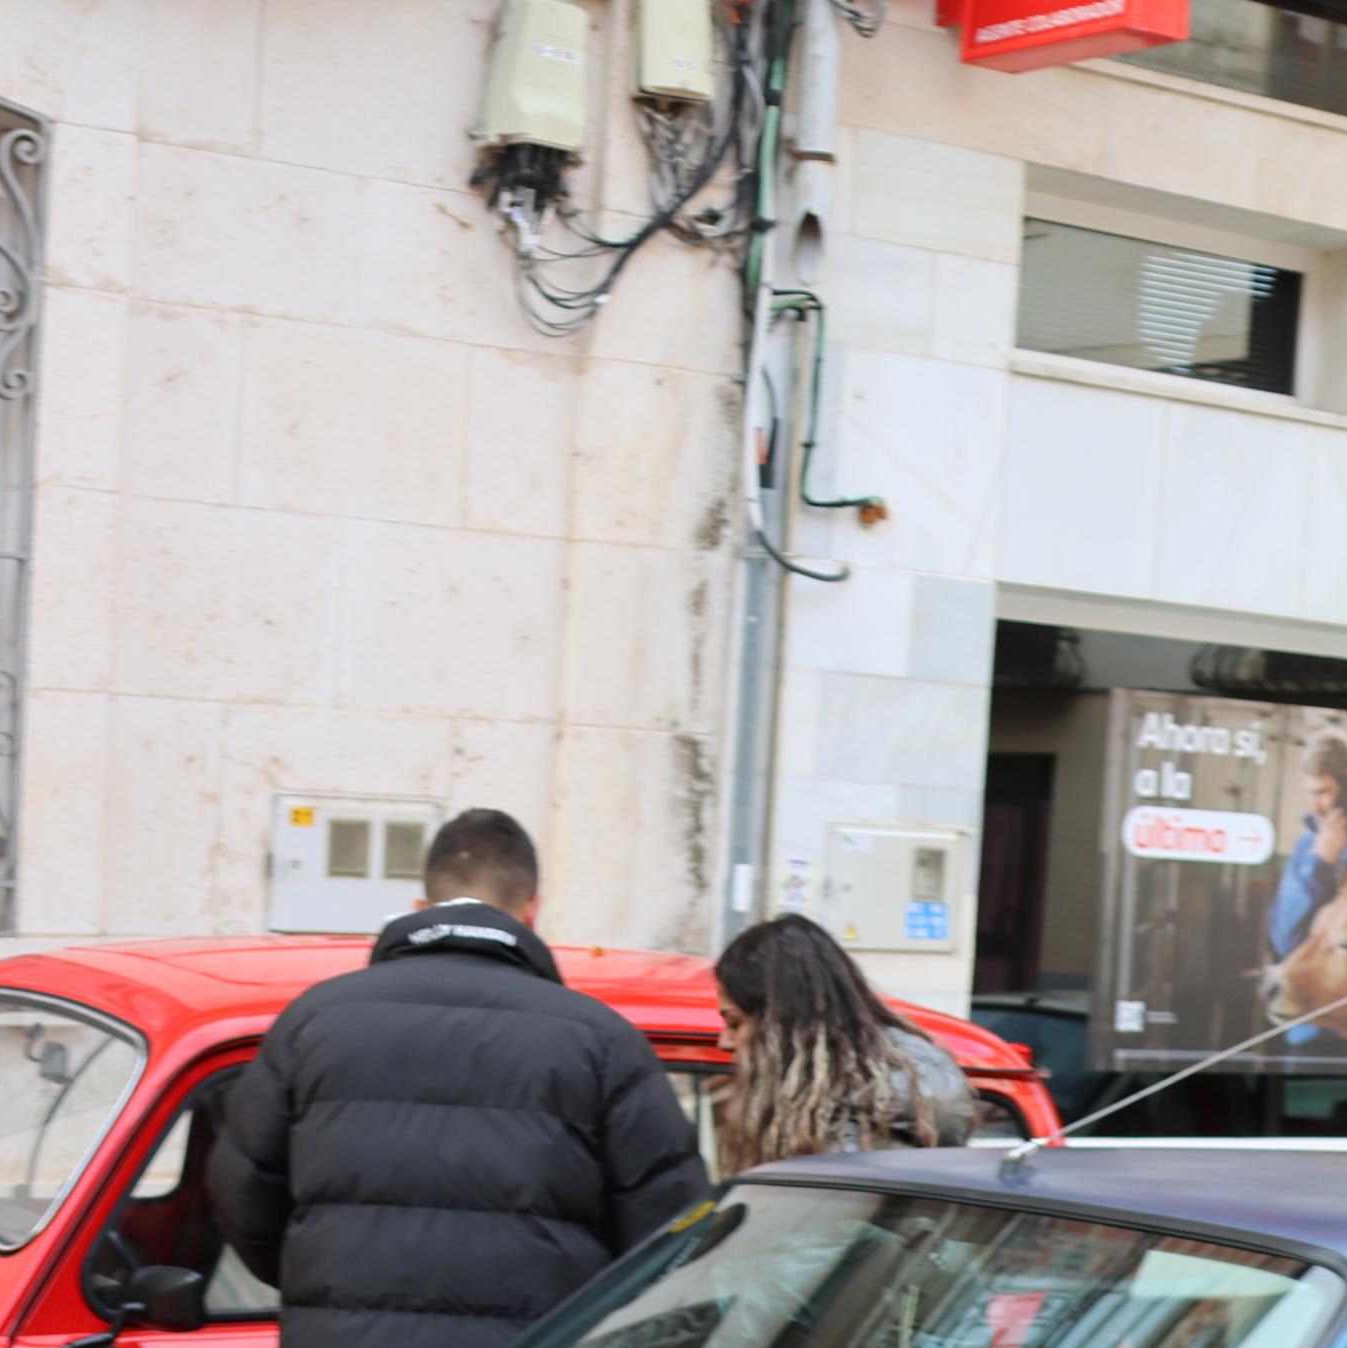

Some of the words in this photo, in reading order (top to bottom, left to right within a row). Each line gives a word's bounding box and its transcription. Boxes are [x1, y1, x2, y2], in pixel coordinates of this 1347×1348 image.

[1138, 712, 1229, 754] Ahora
[1135, 769, 1158, 798] a
[1161, 761, 1192, 800] la
[1134, 813, 1227, 853] última
